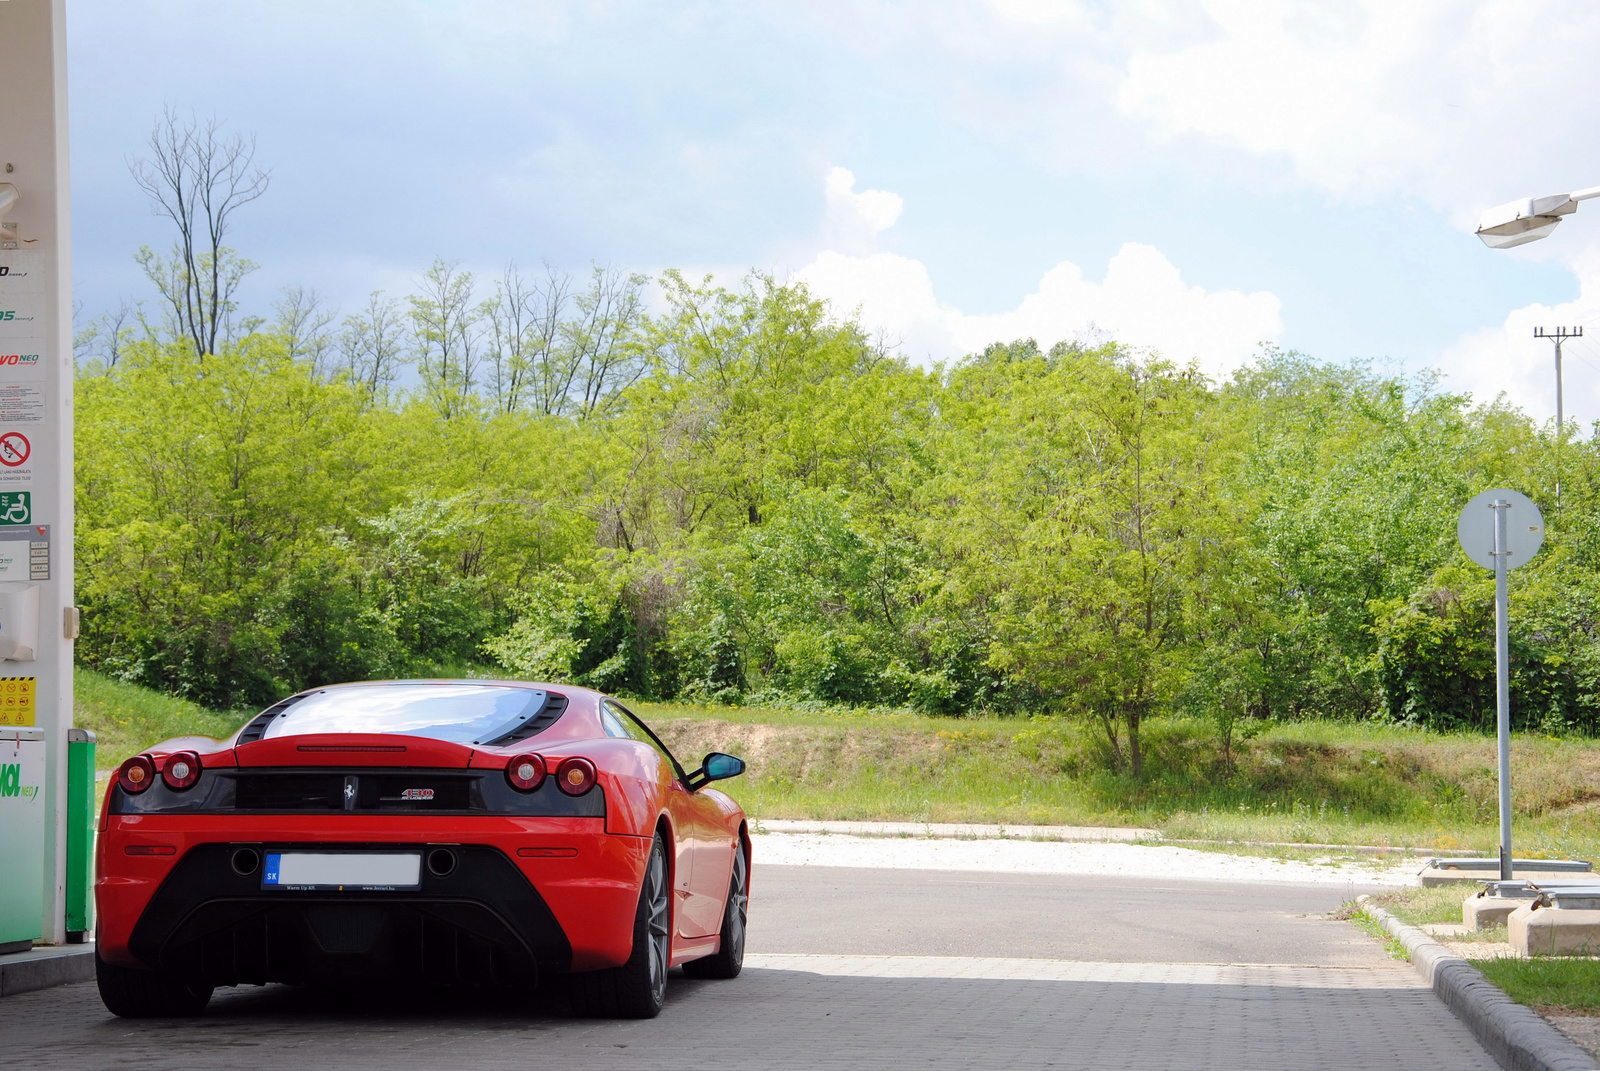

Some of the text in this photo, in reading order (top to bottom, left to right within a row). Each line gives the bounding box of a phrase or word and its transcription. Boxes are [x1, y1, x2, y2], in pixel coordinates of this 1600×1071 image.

[19, 354, 39, 362] NEO
[21, 786, 34, 797] NEO
[401, 788, 435, 796] 430
[266, 872, 277, 880] SK
